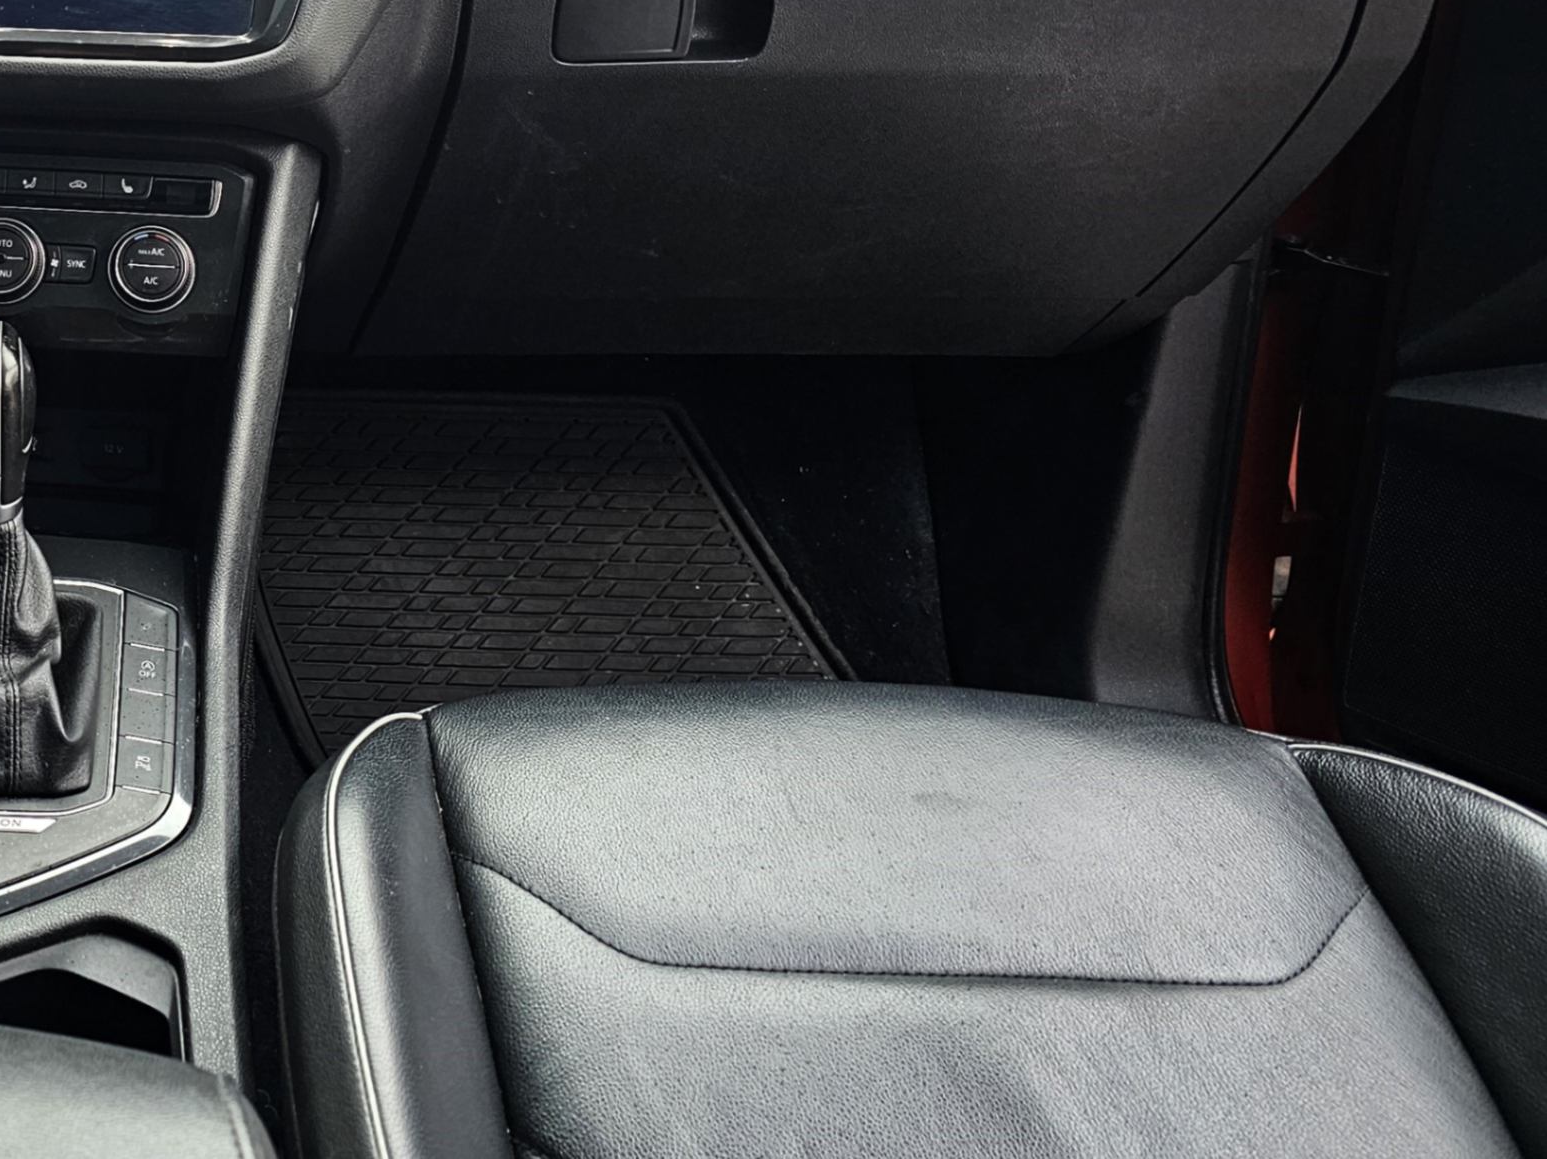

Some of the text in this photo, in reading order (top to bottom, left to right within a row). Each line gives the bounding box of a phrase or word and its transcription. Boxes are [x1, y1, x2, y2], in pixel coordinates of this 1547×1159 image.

[66, 259, 87, 269] SYNC
[143, 276, 159, 286] A/C
[139, 669, 156, 679] OFF
